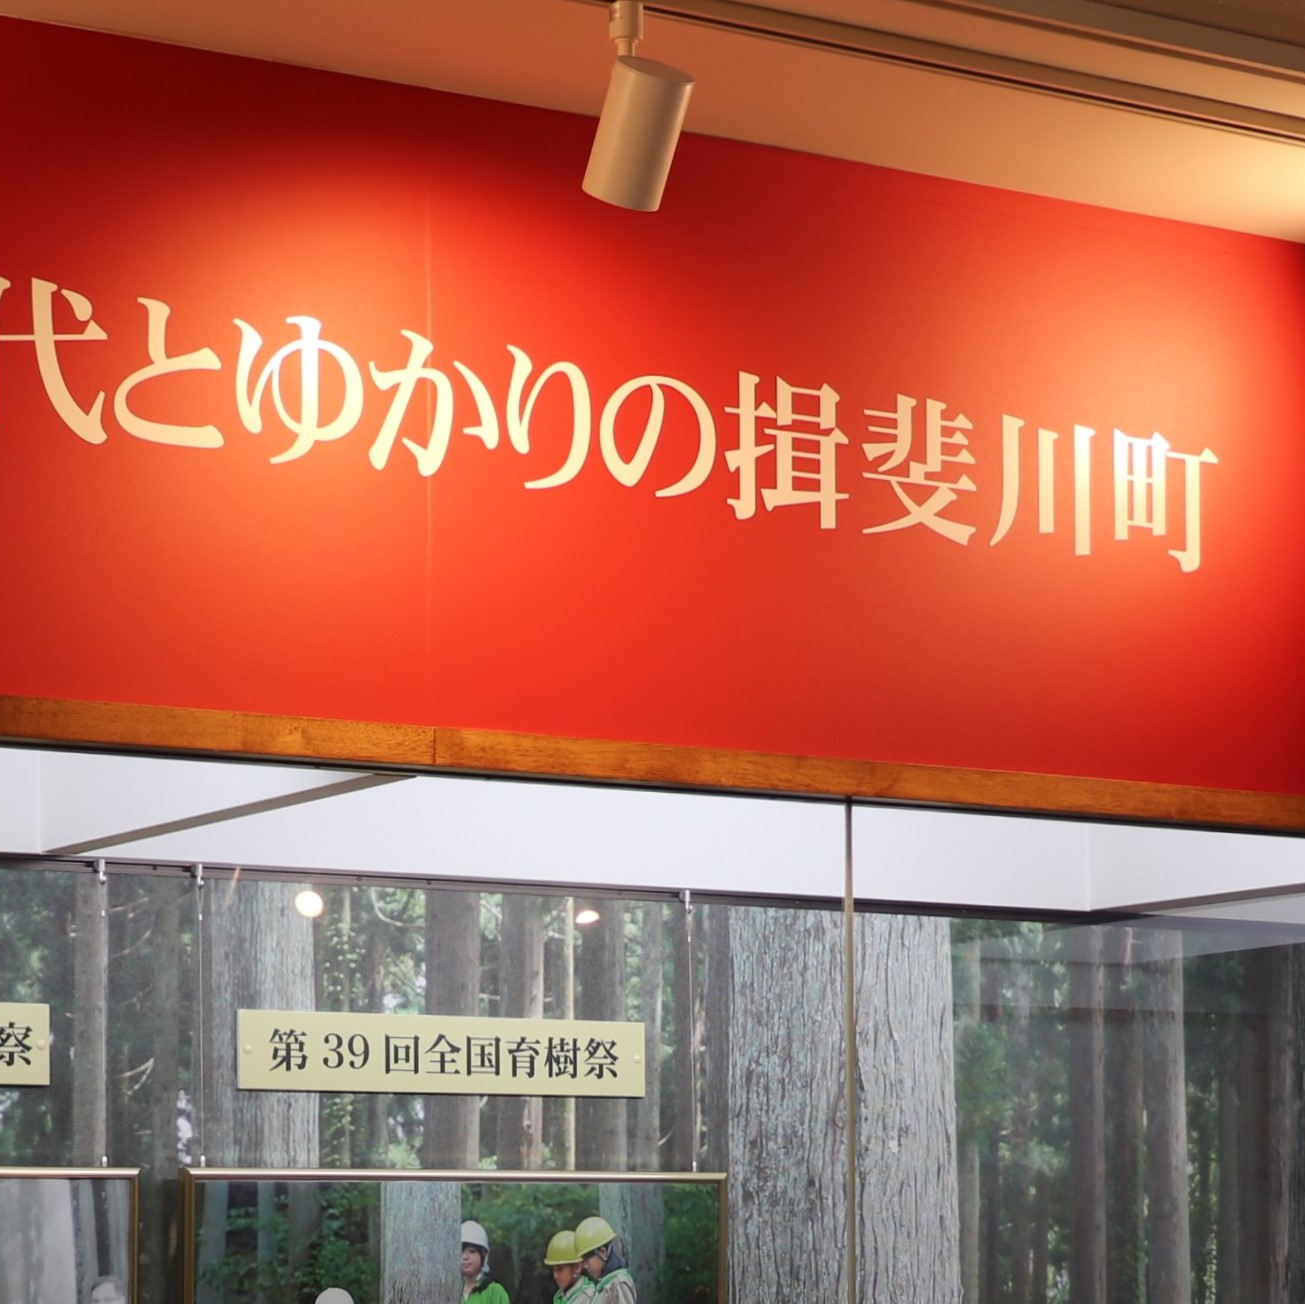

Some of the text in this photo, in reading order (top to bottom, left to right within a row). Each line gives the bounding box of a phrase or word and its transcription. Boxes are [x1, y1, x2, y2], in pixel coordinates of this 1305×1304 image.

[269, 1028, 619, 1080] 第39回全国育樹祭
